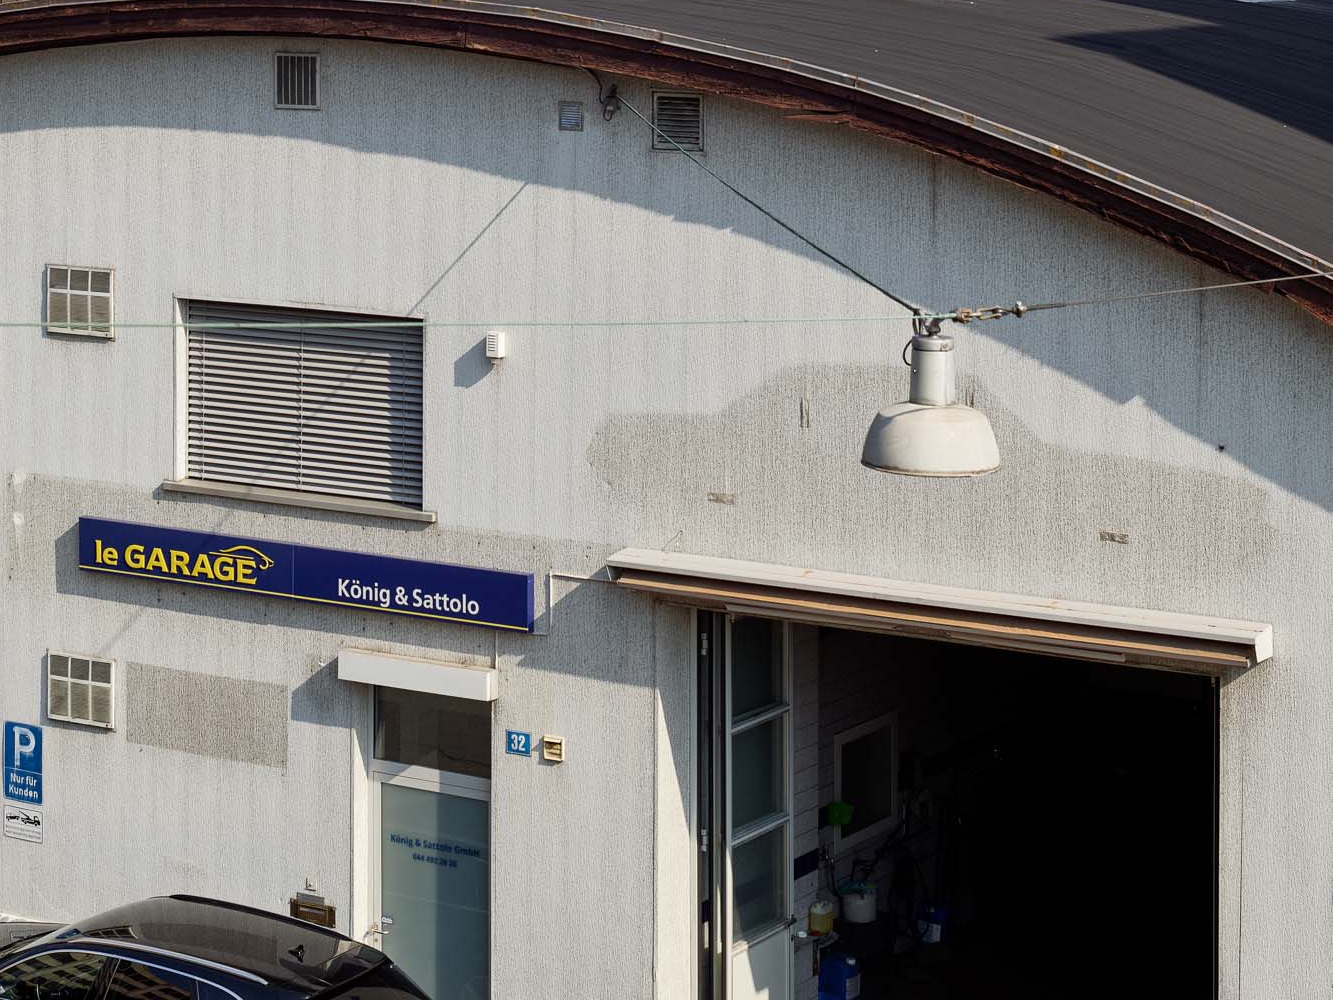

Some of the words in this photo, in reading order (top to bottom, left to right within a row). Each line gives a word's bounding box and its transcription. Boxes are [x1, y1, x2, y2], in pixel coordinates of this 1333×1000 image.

[95, 539, 118, 566] le
[125, 544, 258, 585] GARAGE
[338, 578, 391, 607] König
[395, 586, 408, 606] &
[412, 588, 480, 616] Sattolo
[12, 726, 36, 768] P
[511, 734, 526, 751] 32
[8, 784, 38, 799] Kunden
[10, 772, 24, 784] Nur
[26, 775, 37, 787] für
[390, 833, 413, 848] König
[415, 839, 421, 847] &
[423, 840, 452, 853] Sattolo
[454, 846, 481, 857] GmbH
